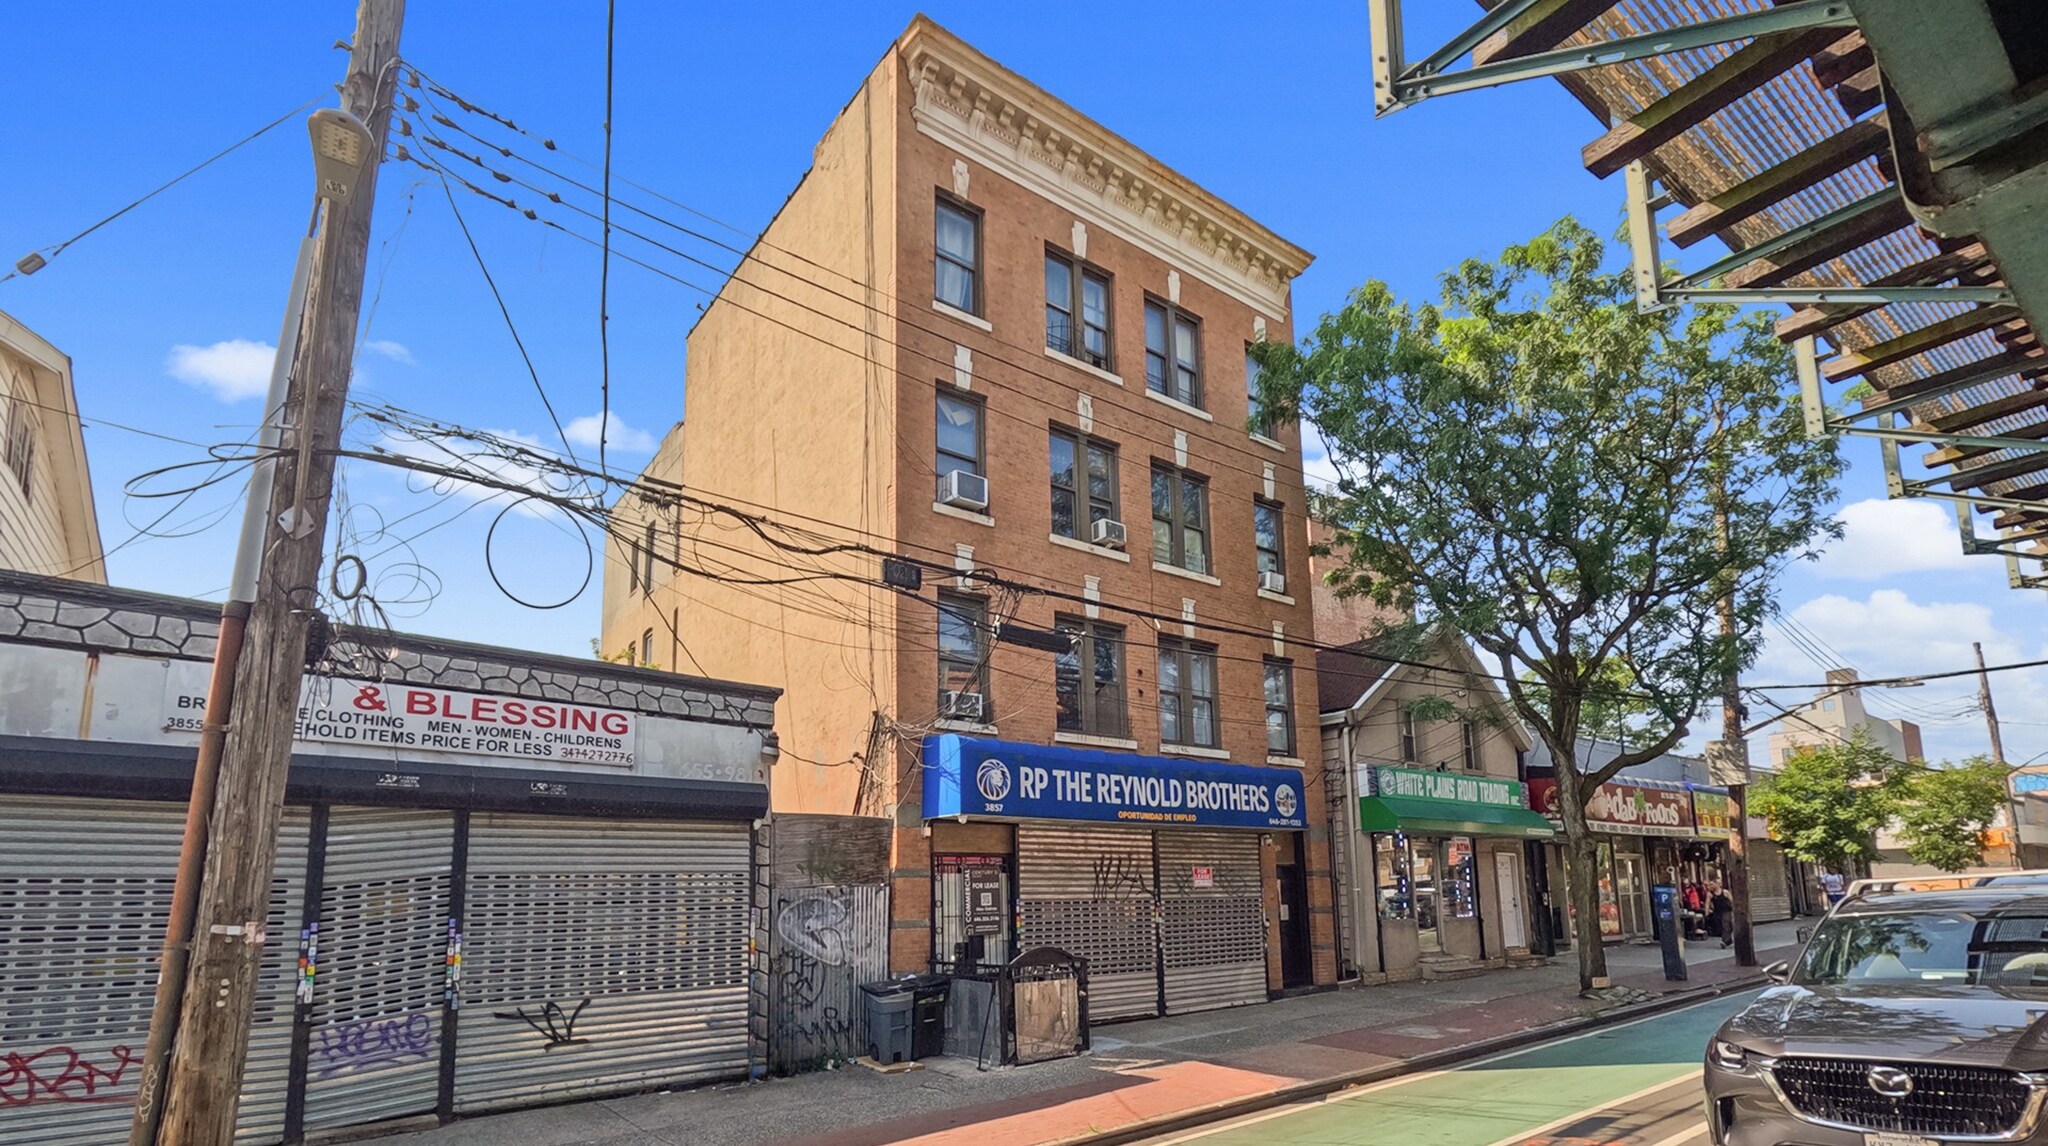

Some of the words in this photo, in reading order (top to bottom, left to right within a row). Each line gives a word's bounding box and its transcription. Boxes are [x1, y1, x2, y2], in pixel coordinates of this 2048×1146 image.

[316, 709, 404, 729] CLOTHING
[428, 720, 462, 734] MEN
[475, 725, 532, 741] WOMEN
[544, 732, 622, 749] CHILDRENS
[353, 686, 387, 712] &
[406, 690, 629, 736] BLESSING
[167, 716, 204, 729] 3855
[363, 729, 416, 745] ITEMS
[421, 733, 471, 750] PRICE
[476, 738, 509, 753] FOR
[519, 743, 552, 756] LESS
[1019, 766, 1049, 799] RP
[1052, 769, 1093, 802] THE
[1097, 773, 1182, 808] REYNOLD
[1185, 780, 1270, 813] BROTHERS
[1396, 772, 1425, 795] WHITE
[1425, 776, 1455, 799] PLAINS
[1457, 779, 1477, 802] ROAD
[1479, 782, 1509, 804] TRADING
[984, 802, 1004, 812] 3857
[1118, 810, 1163, 821] OPORTUNIDAD
[1164, 813, 1172, 821] DE
[1173, 814, 1197, 822] EMPLEO
[1661, 893, 1668, 903] P
